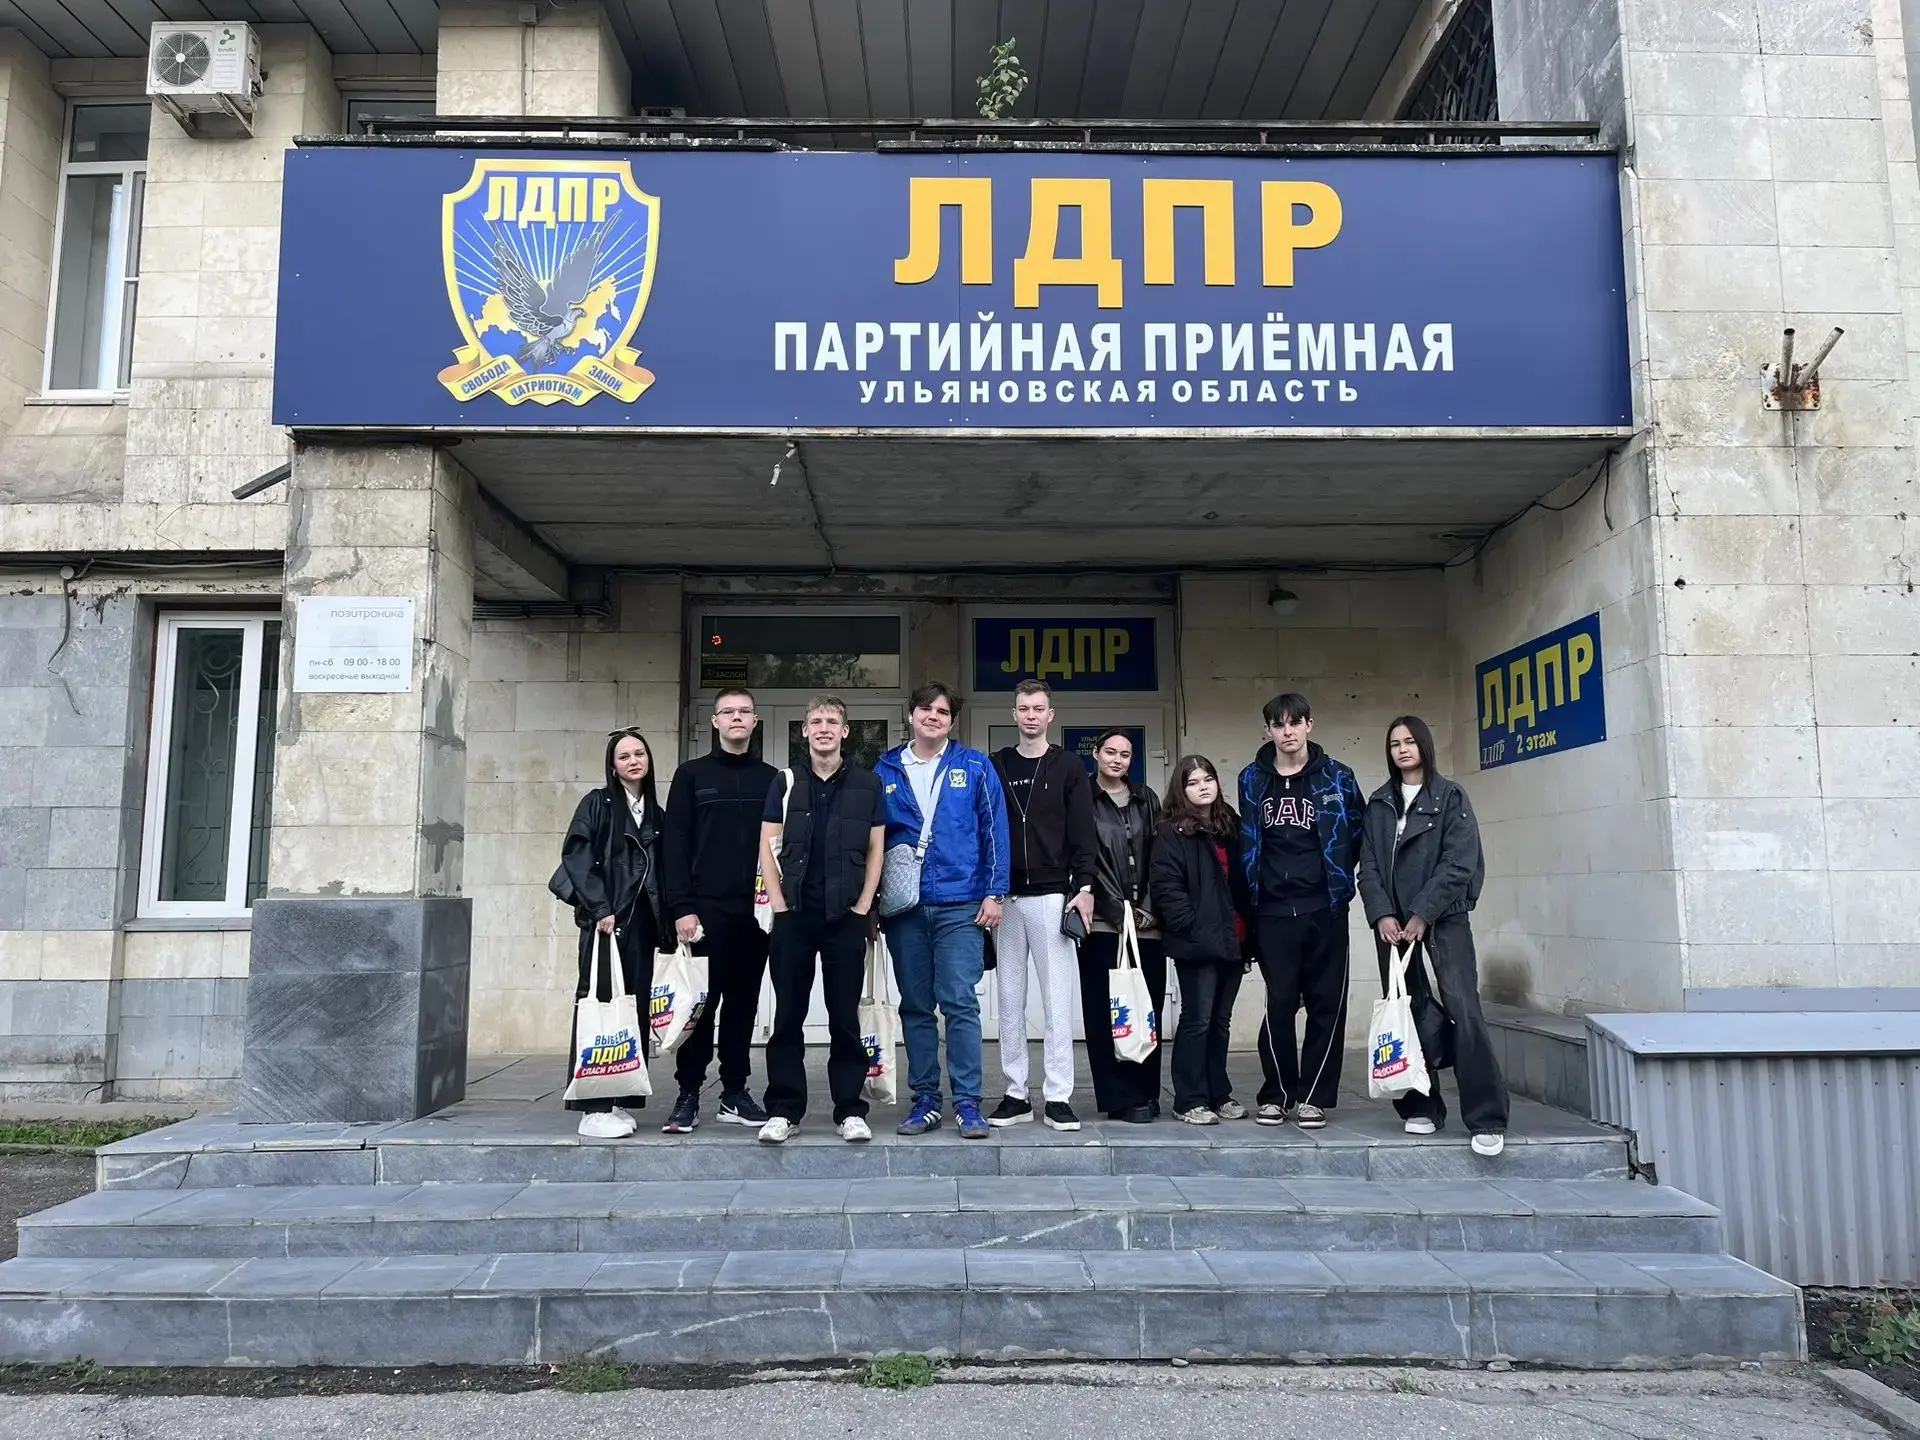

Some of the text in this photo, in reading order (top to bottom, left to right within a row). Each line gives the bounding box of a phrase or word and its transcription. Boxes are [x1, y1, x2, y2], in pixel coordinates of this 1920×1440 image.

[483, 176, 621, 229] ЛДПР
[893, 177, 1343, 309] ЛДПР
[774, 311, 1454, 371] ПАРТИЙНАЯ ПРИЁМНАЯ
[460, 360, 511, 395] СВОБОДА
[510, 380, 583, 400] ПАТРИОТИЗМ
[588, 365, 624, 392] ЗАКОН
[859, 380, 1358, 403] УЛЬЯНОВСКАЯ ОБЛАСТЬ
[1000, 628, 1130, 680] ЛДПР
[1482, 633, 1594, 734] ЛДПР
[1516, 730, 1557, 754] 2 этаж
[594, 1028, 629, 1046] ВЫБЕРИ
[587, 1042, 631, 1065] ЛДПР
[581, 1066, 606, 1076] СПАСИ
